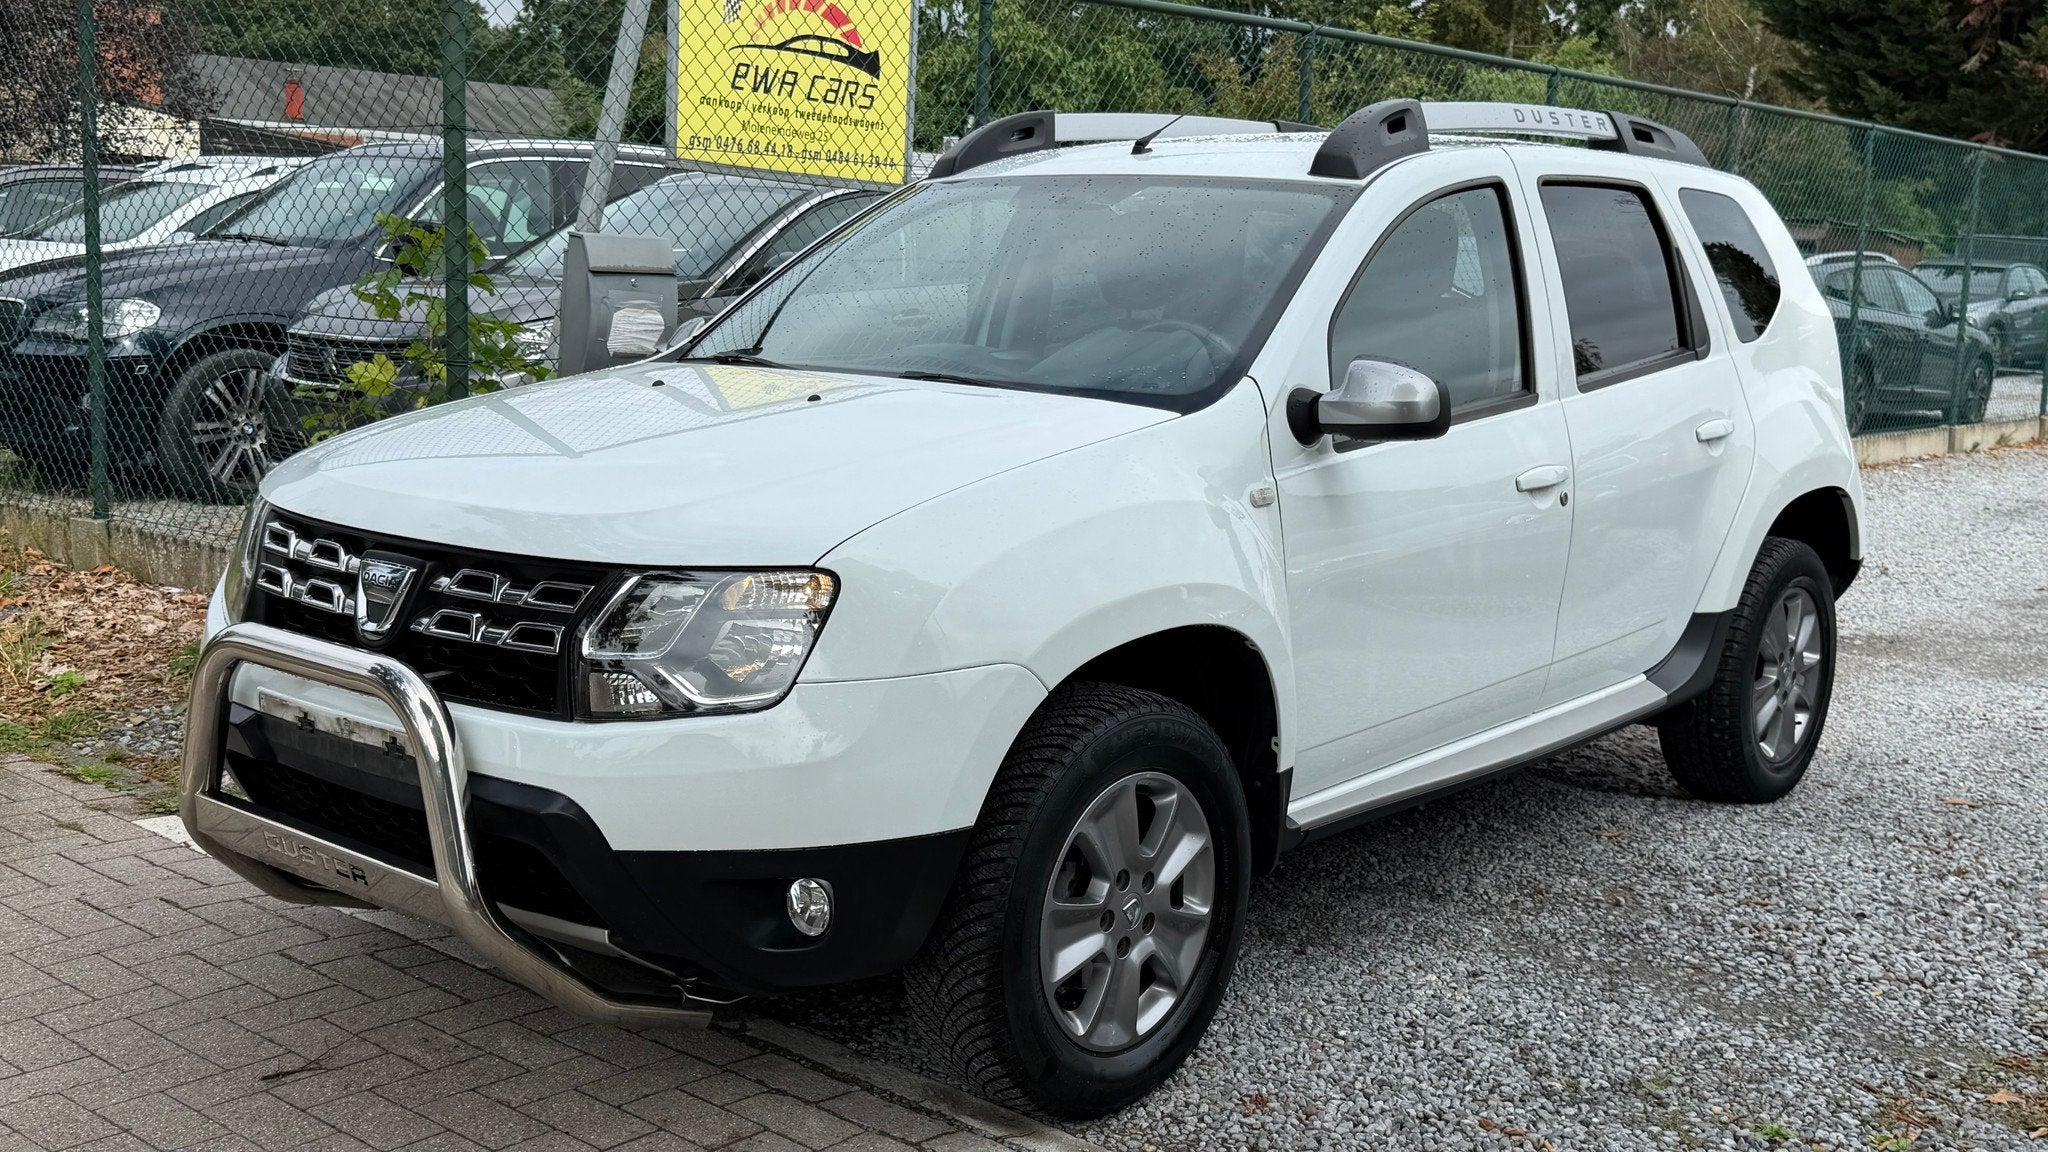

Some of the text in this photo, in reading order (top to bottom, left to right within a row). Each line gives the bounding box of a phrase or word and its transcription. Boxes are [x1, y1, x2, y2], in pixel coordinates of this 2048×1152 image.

[700, 95, 742, 113] aankoop
[752, 102, 790, 119] verkoop
[795, 109, 884, 131] tweedehandswagens
[1513, 108, 1608, 132] DUSTER
[689, 135, 711, 150] gsm
[819, 130, 830, 142] 25
[363, 571, 398, 589] DACIA
[263, 830, 369, 887] DUSTER
